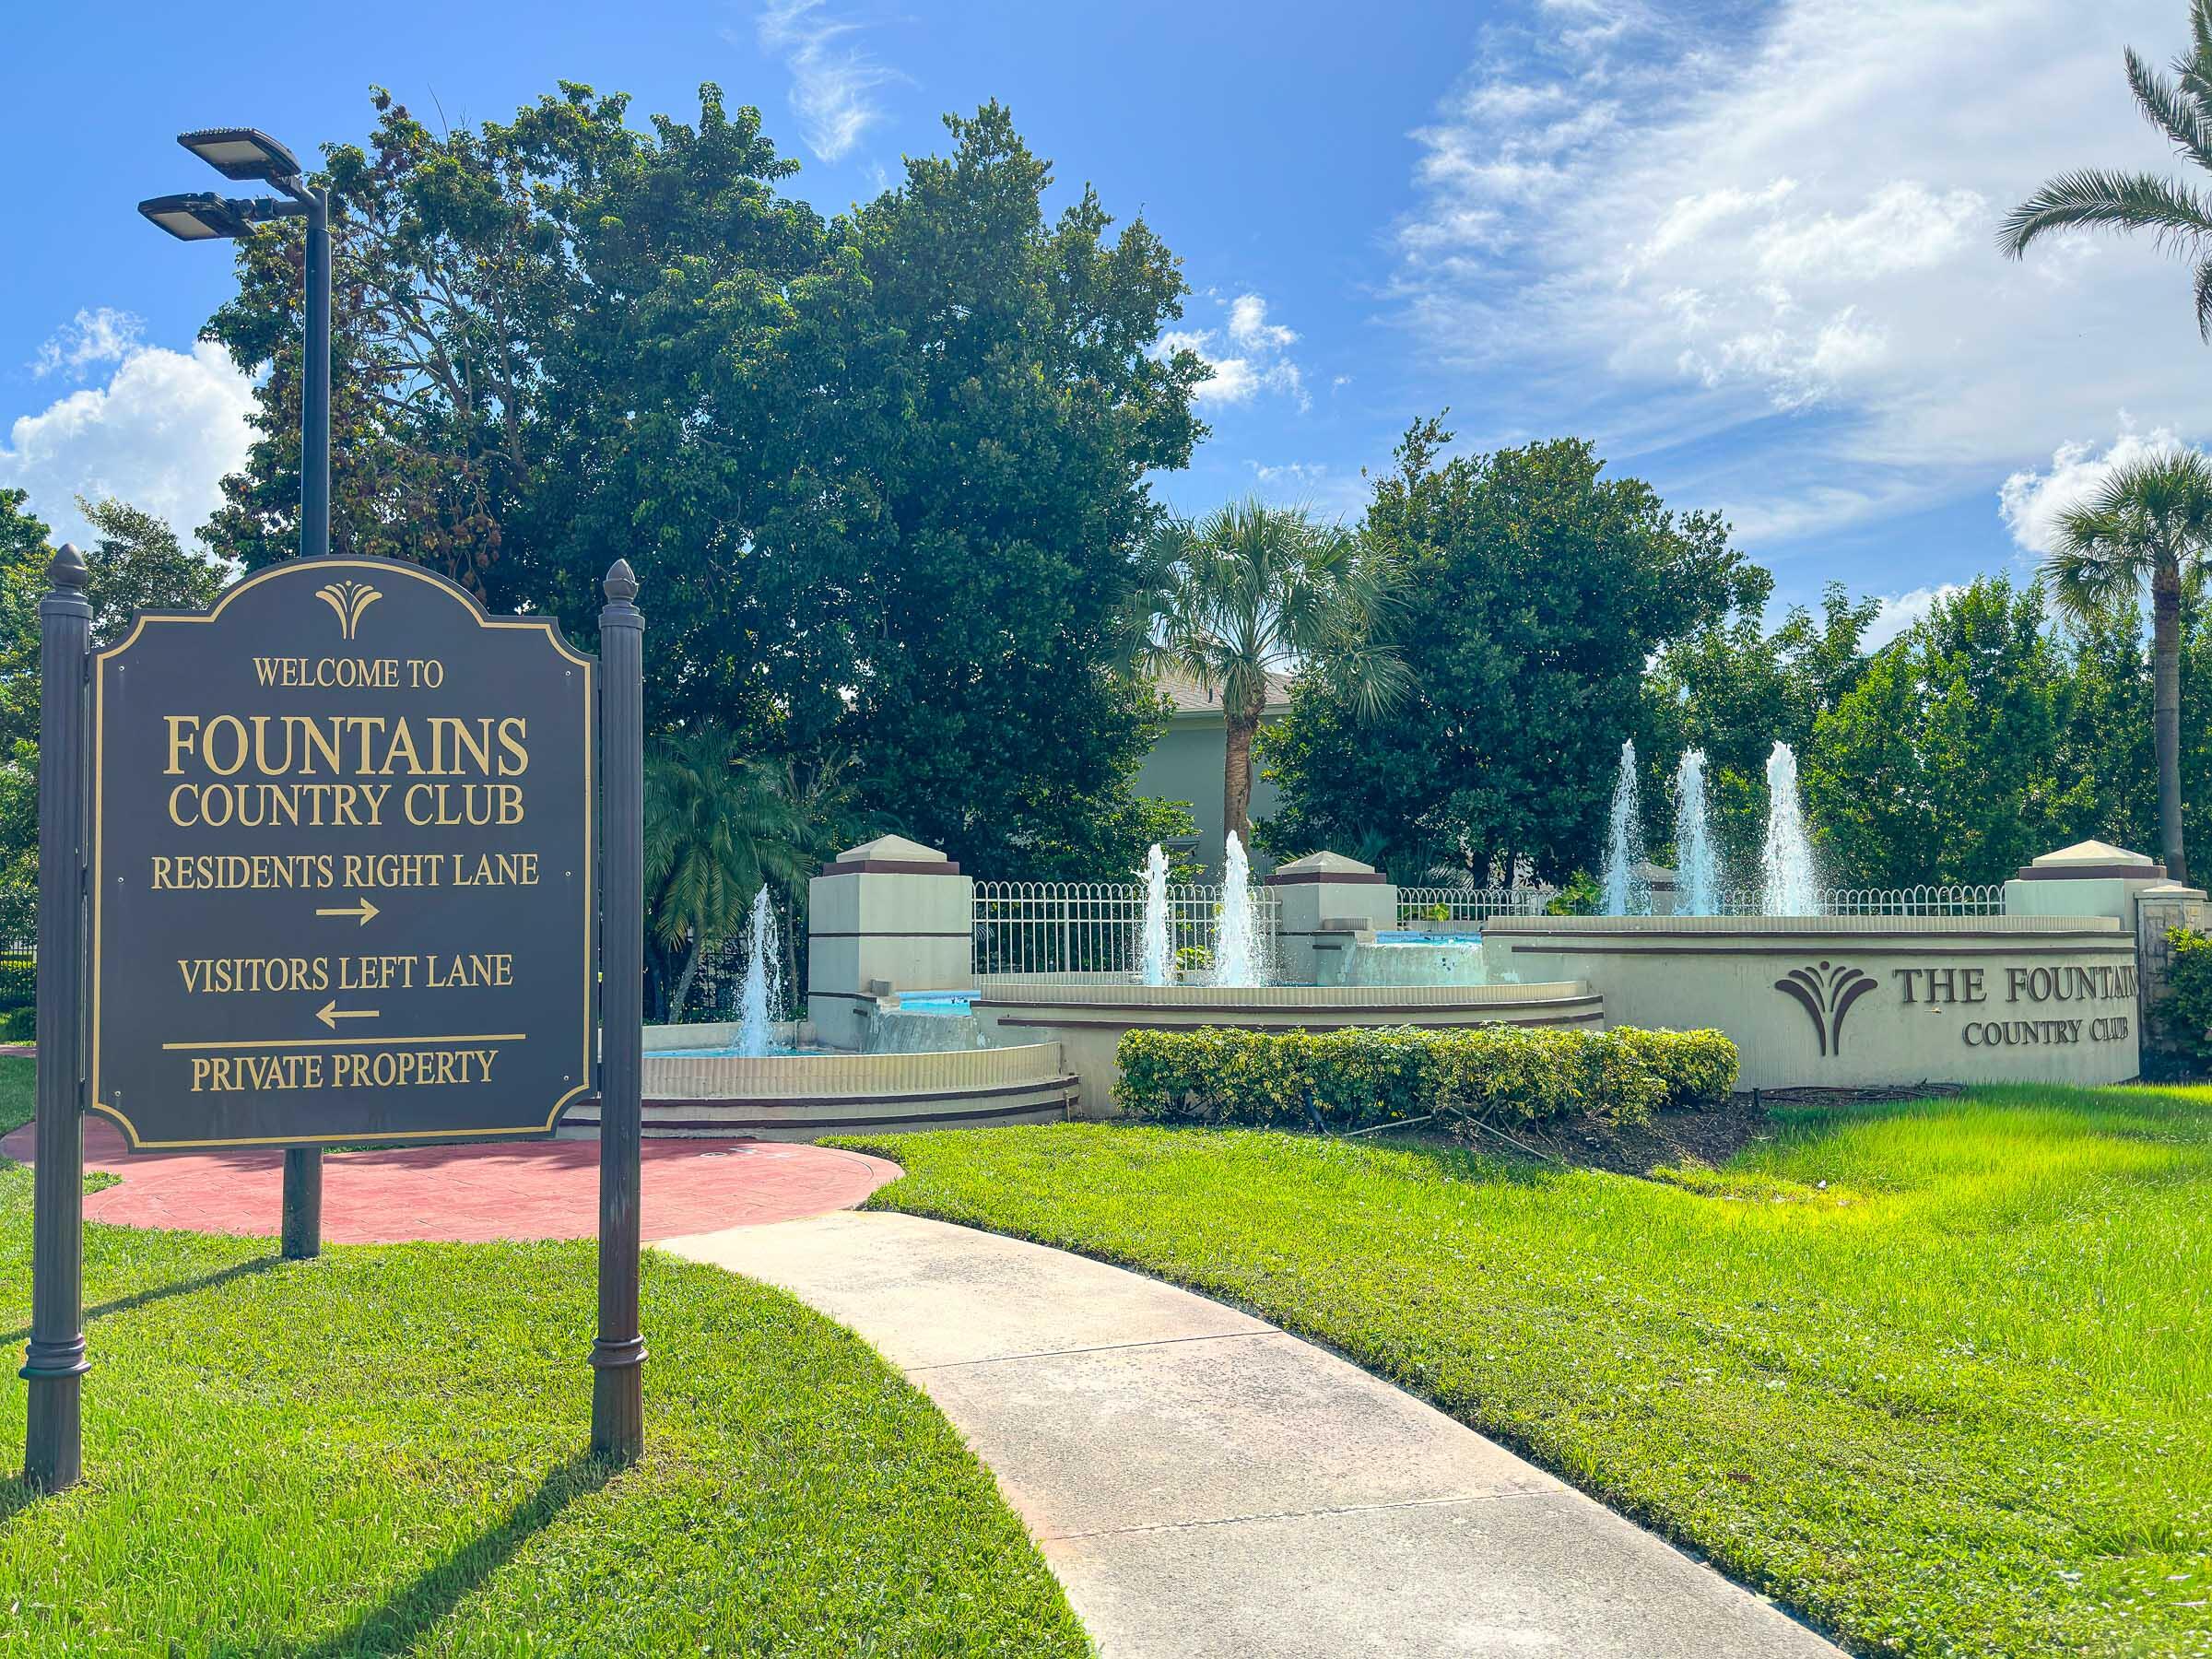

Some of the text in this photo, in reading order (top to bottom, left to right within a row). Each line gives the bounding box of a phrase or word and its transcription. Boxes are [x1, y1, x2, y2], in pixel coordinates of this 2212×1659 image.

[253, 657, 443, 688] WELCOME TO
[163, 714, 529, 777] FOUNTAINS
[168, 783, 524, 827] COUNTRY CLUB
[151, 853, 539, 890] RESIDENTS RIGHT LANE
[178, 953, 513, 994] VISITORS LEFT LANE
[1893, 968, 1986, 1004] THE
[1962, 1017, 2129, 1047] COUNTRY CLUB
[191, 1050, 499, 1092] PRIVATE PROPERTY
